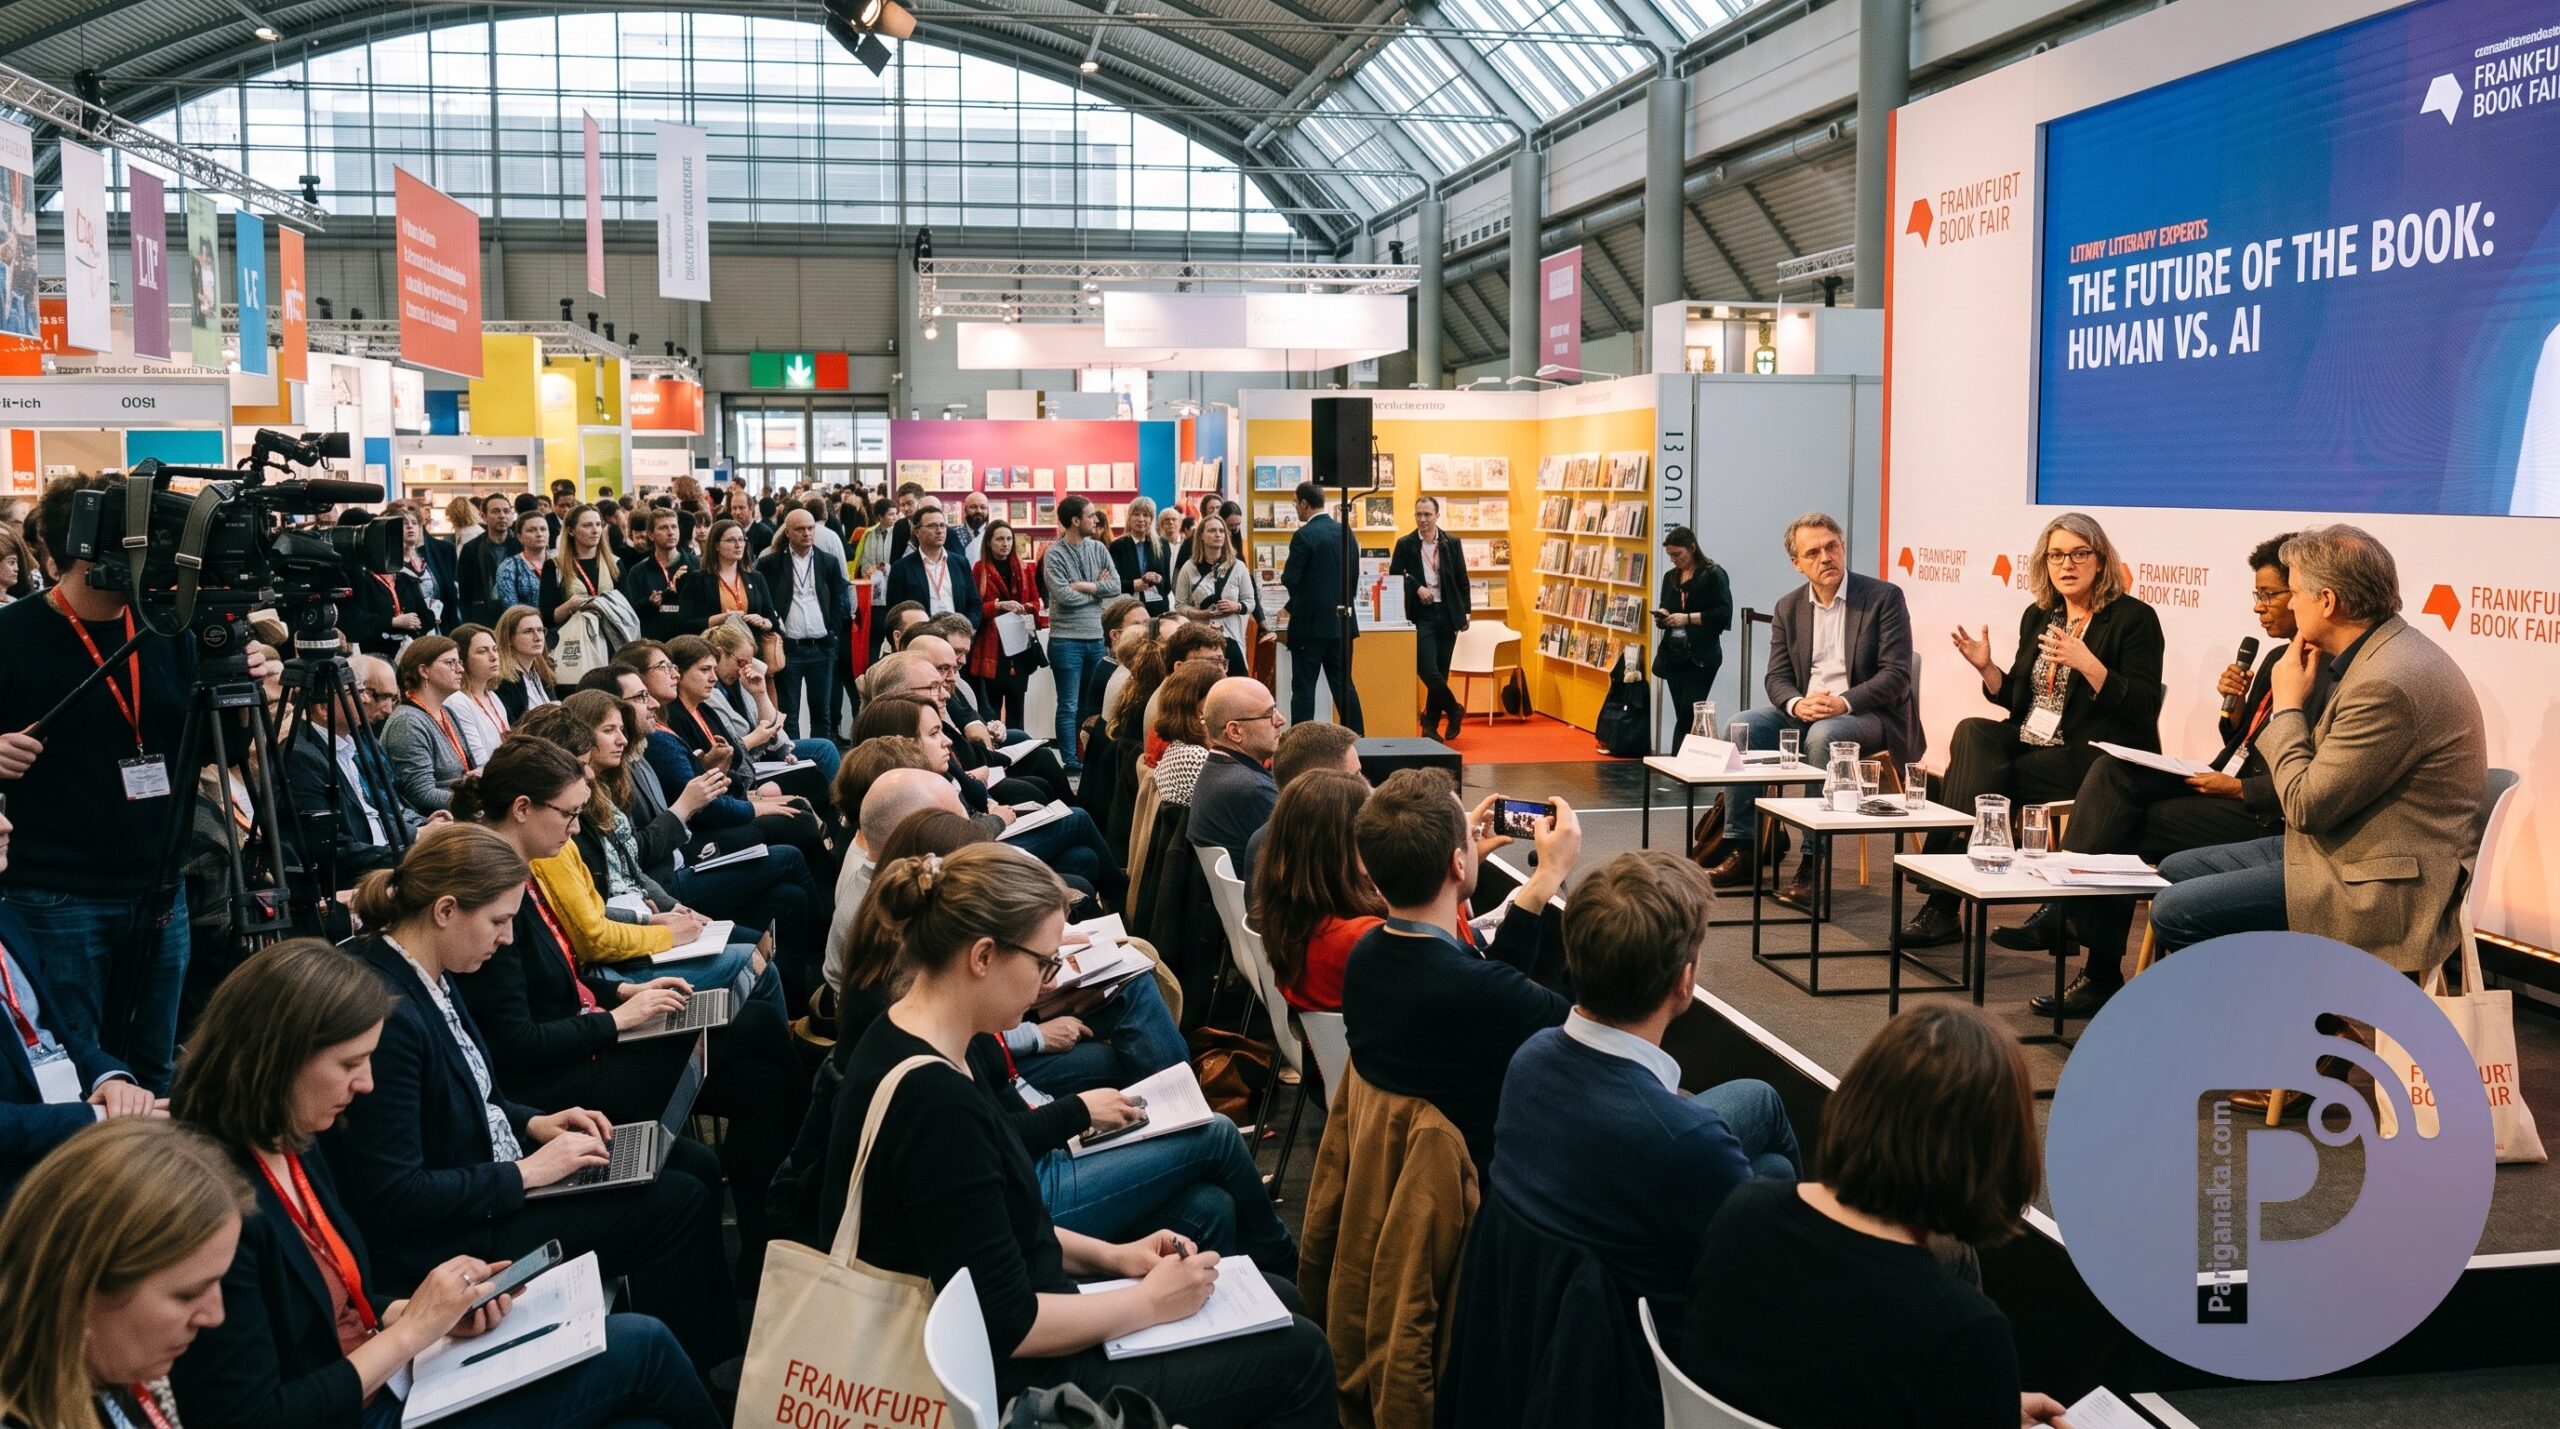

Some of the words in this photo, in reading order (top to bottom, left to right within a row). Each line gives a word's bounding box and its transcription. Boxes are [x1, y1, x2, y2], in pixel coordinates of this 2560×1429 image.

[2474, 45, 2560, 90] FRANKFU
[2473, 83, 2523, 118] BOOK
[2529, 74, 2560, 105] FAI
[1940, 171, 2021, 217] FRANKFURT
[1939, 214, 1975, 246] BOOK
[1979, 205, 2010, 236] FAIR
[2159, 218, 2208, 247] EXPERTS
[2068, 268, 2117, 317] THE
[2125, 247, 2232, 309] FUTURE
[2241, 237, 2283, 291] OF
[2291, 224, 2359, 283] THE
[2371, 201, 2496, 272] BOOK:
[2068, 317, 2164, 371] HUMAN
[2174, 310, 2218, 360] VS.
[2228, 304, 2261, 355] AI
[1919, 547, 1967, 566] FRANKFURT
[1919, 565, 1940, 581] BOOK
[1942, 567, 1960, 583] FAIR
[2139, 563, 2209, 587] FRANKFURT
[2139, 585, 2170, 605] BOOK
[2173, 588, 2200, 608] FAIR
[2471, 586, 2560, 616] FRANKFU
[2470, 613, 2519, 640] BOOK
[784, 1359, 948, 1429] FRANKFURT
